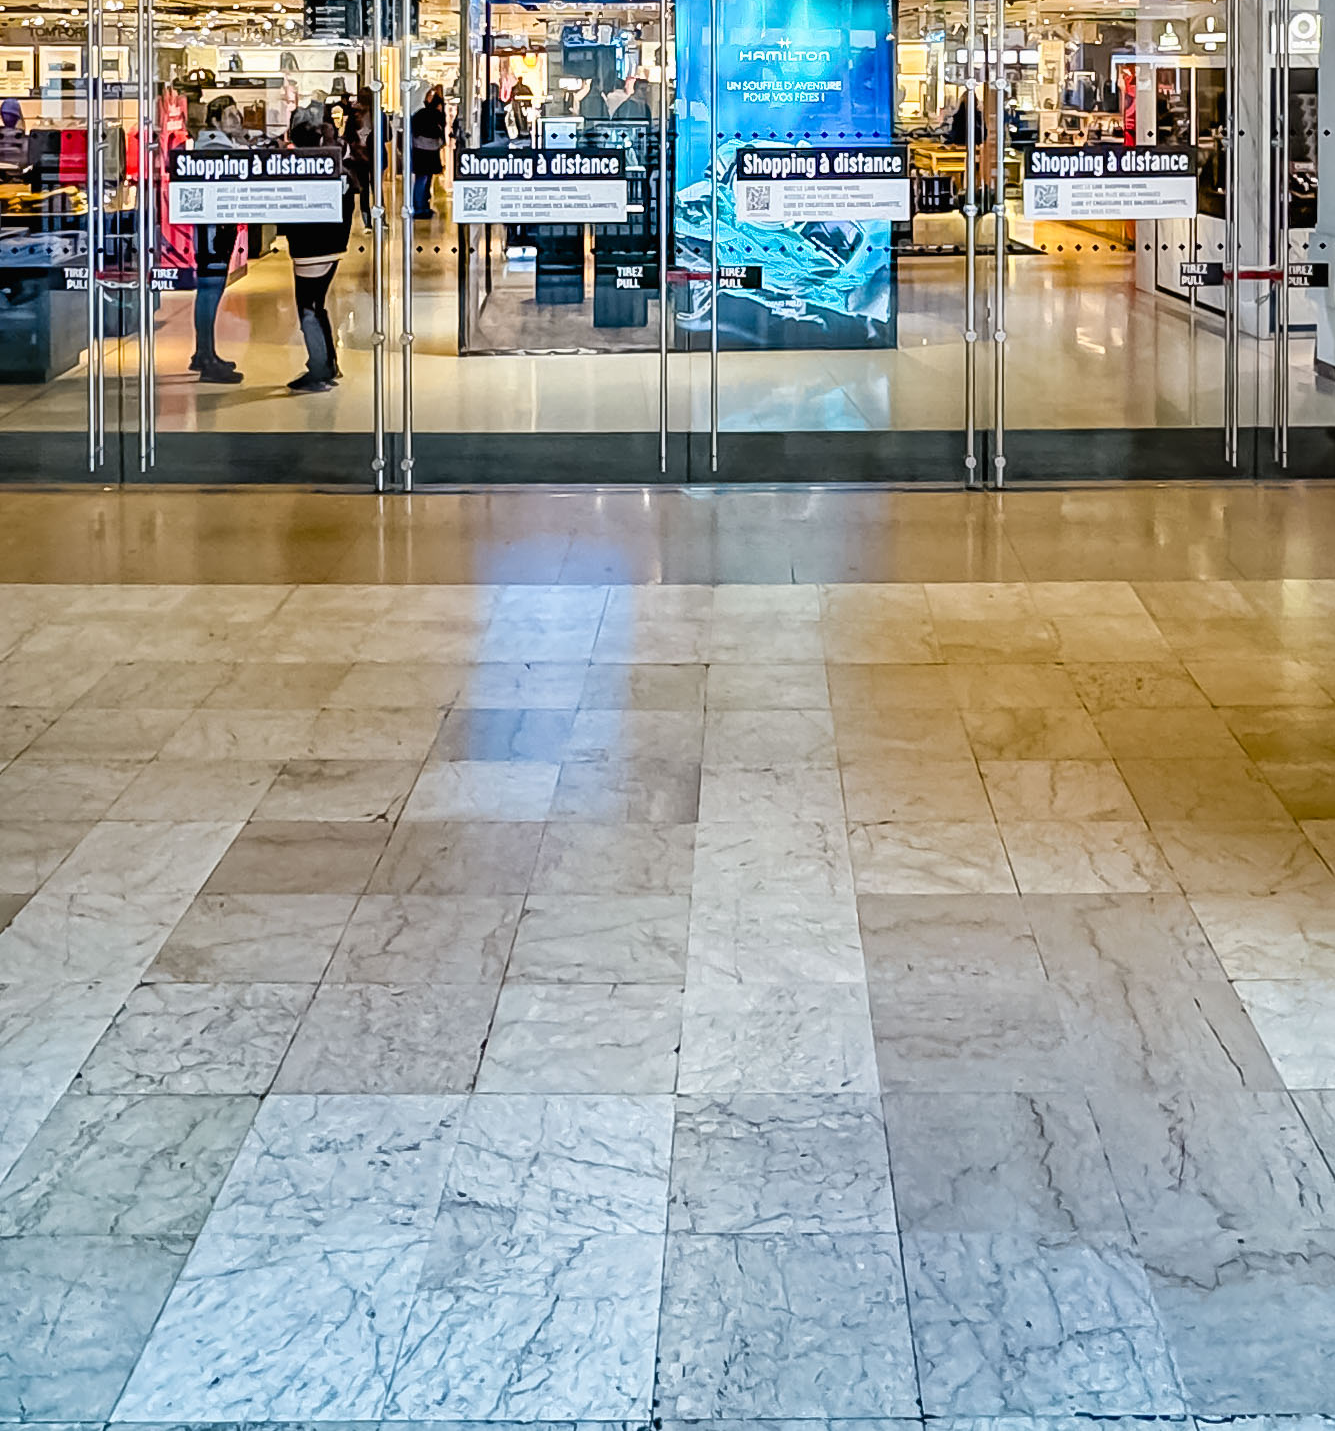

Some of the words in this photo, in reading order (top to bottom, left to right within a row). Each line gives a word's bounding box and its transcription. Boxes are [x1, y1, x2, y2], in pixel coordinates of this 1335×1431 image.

[739, 50, 831, 62] HAMILTON
[726, 81, 741, 90] UN
[744, 92, 771, 102] POUR
[772, 92, 793, 102] VOS
[176, 154, 249, 180] Shopping
[252, 154, 263, 175] à
[266, 154, 334, 175] distance
[460, 153, 533, 179] Shopping
[536, 153, 547, 174] à
[551, 153, 619, 174] distance
[743, 153, 816, 178] Shopping
[819, 152, 830, 173] à
[833, 152, 902, 173] distance
[1031, 151, 1104, 176] Shopping
[1107, 151, 1117, 172] à
[1121, 150, 1189, 172] distance
[152, 268, 178, 279] TIREZ
[616, 266, 644, 277] TIREZ
[719, 266, 747, 277] TIREZ
[1181, 264, 1208, 275] TIREZ
[151, 280, 175, 290] PULL
[616, 278, 640, 289] PULL
[719, 278, 743, 288] PULL
[1181, 275, 1204, 286] PULL
